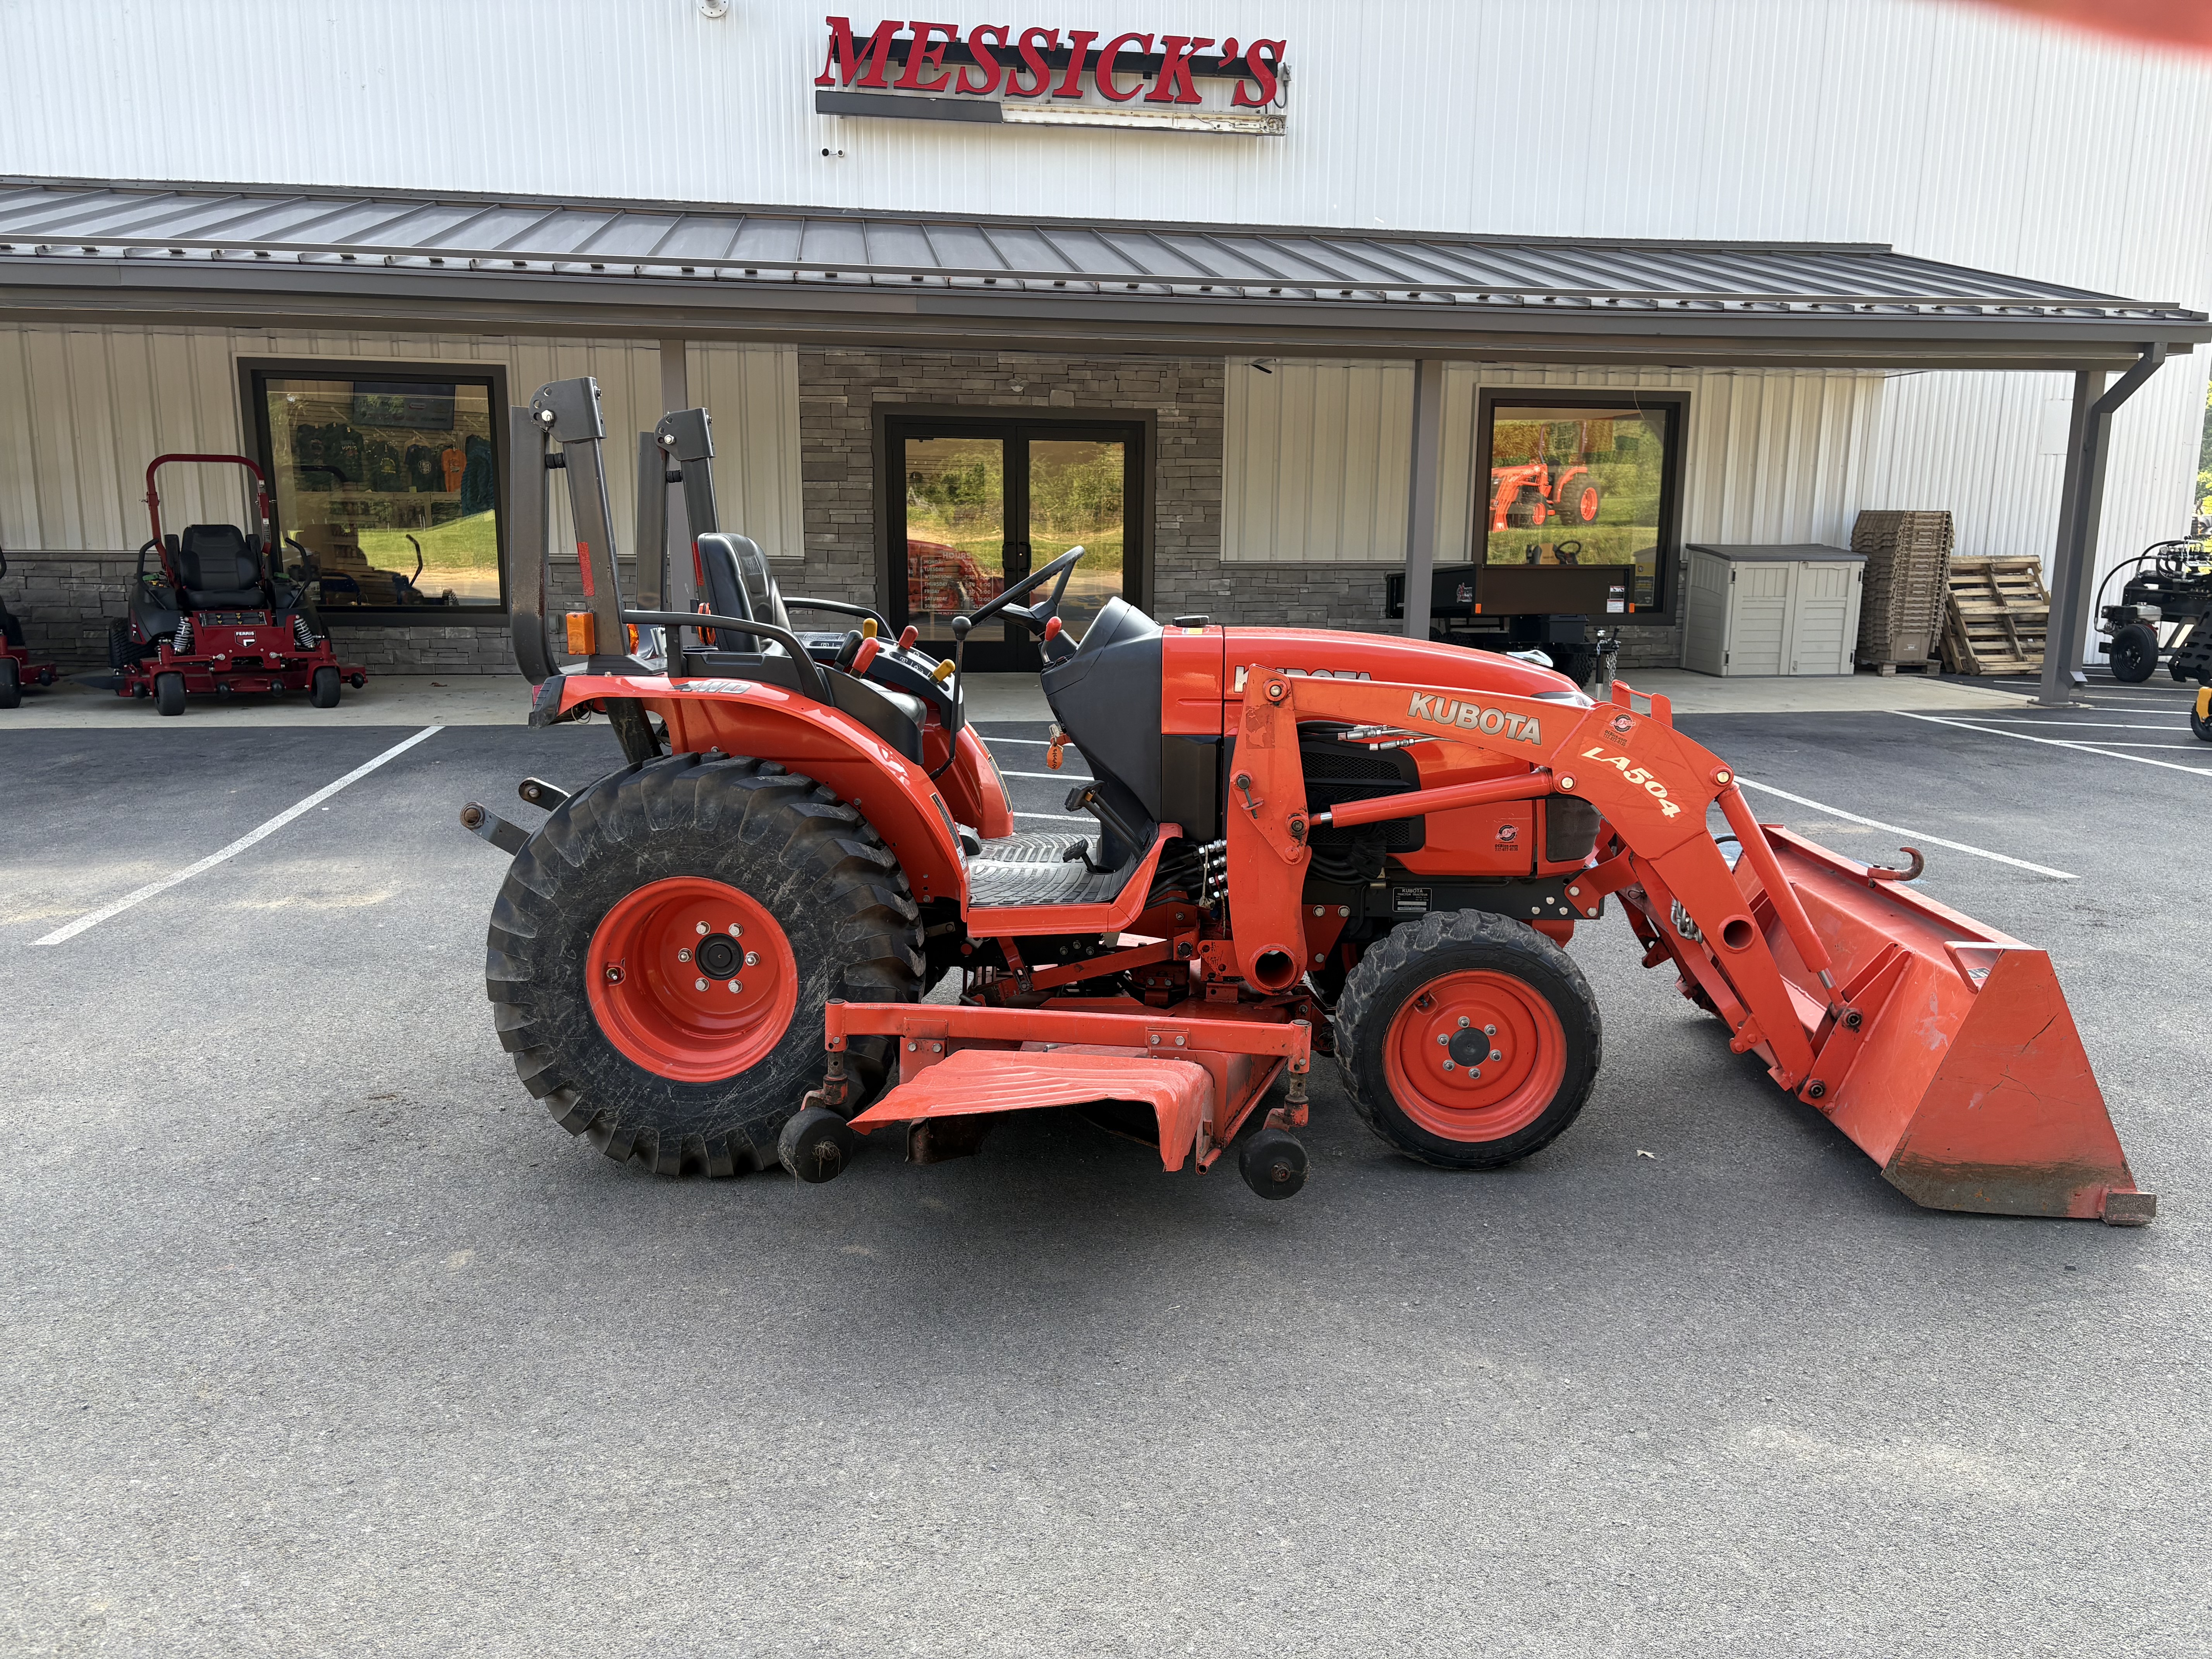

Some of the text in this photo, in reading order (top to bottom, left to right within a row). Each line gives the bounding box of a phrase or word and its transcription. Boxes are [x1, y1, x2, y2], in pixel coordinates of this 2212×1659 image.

[814, 16, 1287, 108] MESSICK'S
[673, 680, 752, 694] 4WD
[1407, 690, 1542, 746] KUBOTA
[1581, 747, 1681, 818] LA504
[1382, 958, 1439, 1008] TRAC
